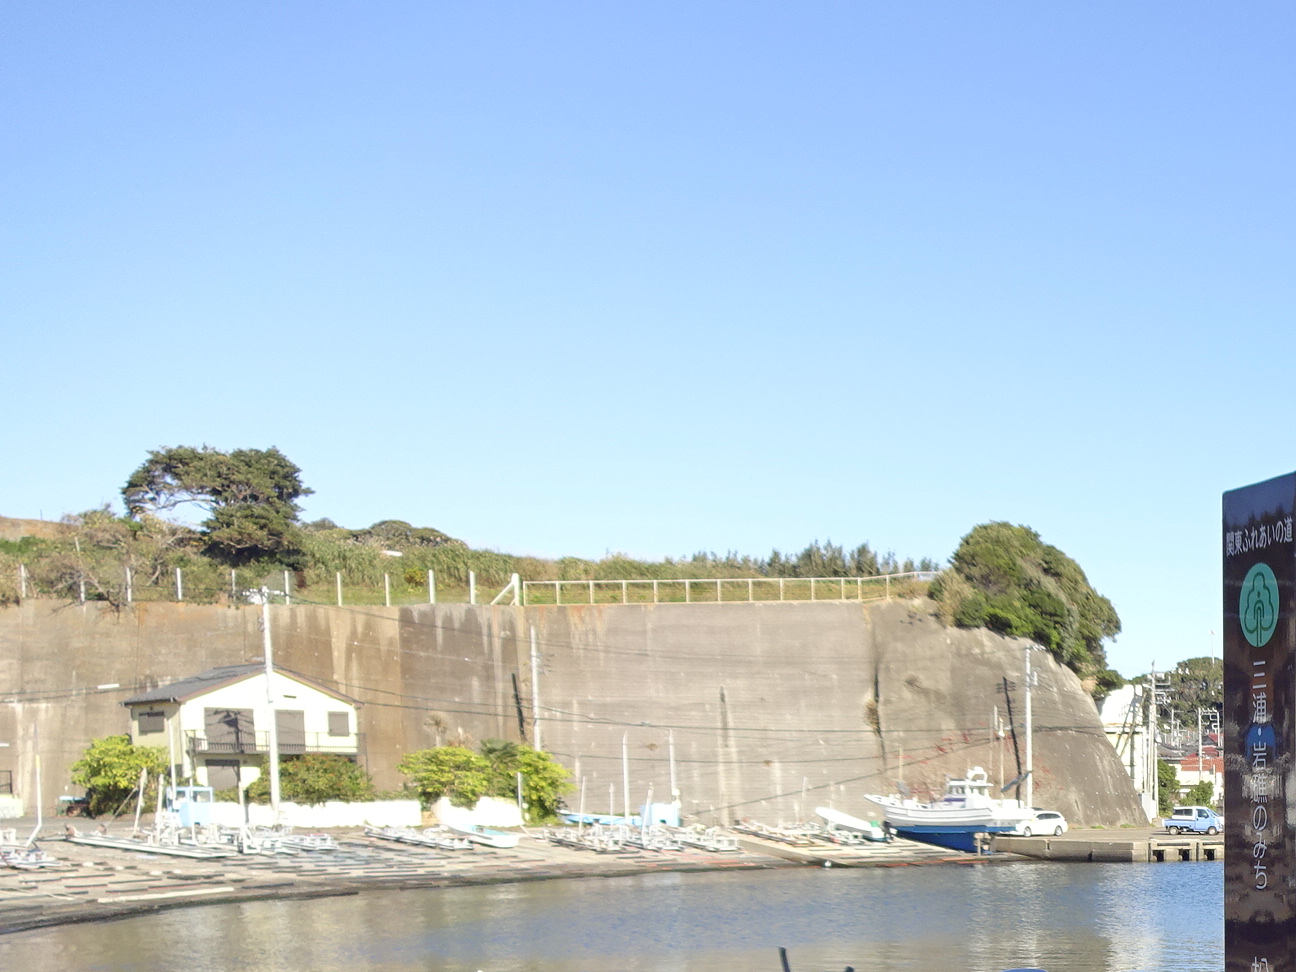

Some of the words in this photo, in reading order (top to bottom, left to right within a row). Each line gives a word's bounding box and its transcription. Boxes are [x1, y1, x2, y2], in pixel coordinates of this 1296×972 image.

[1226, 516, 1293, 557] 関東ふれあいの道
[1251, 660, 1268, 890] 三浦・岩礁のみち
